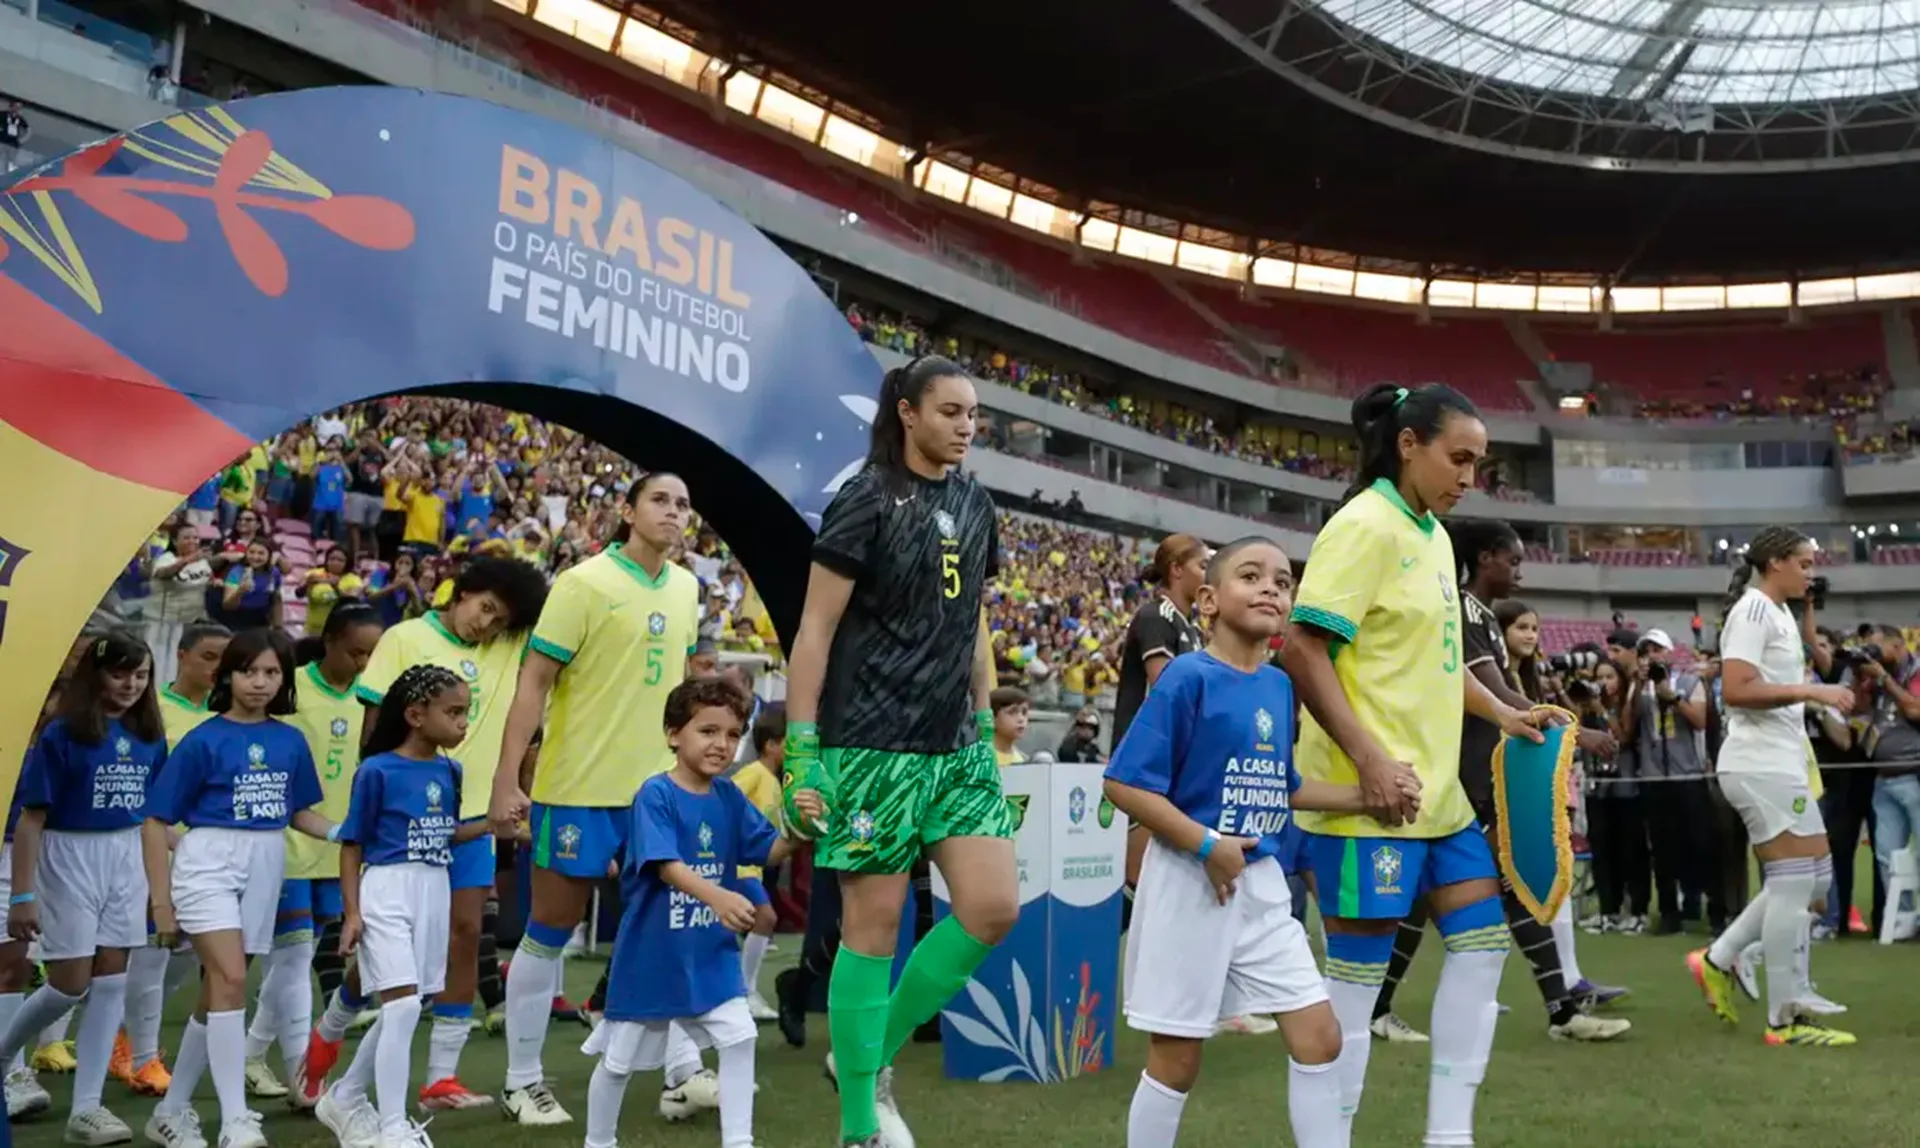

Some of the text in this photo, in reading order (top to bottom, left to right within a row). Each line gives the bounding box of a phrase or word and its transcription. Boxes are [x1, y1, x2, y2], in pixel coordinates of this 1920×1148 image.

[498, 143, 750, 309] BRASIL
[493, 221, 751, 342] O PAÍS DO FUTEBOL
[488, 256, 750, 394] FEMININO
[942, 553, 960, 599] 5
[1443, 620, 1458, 673] 5
[644, 648, 664, 686] 5
[95, 764, 106, 774] A
[107, 764, 135, 774] CASA
[233, 771, 288, 785] A CASA DO
[325, 748, 344, 781] 5
[1225, 757, 1286, 777] A CASA D
[93, 781, 145, 793] MUNDIA
[108, 793, 146, 810] AQU
[233, 802, 249, 820] É
[408, 818, 418, 829] A
[1218, 804, 1288, 837] É AQUI
[670, 904, 722, 929] É AQ
